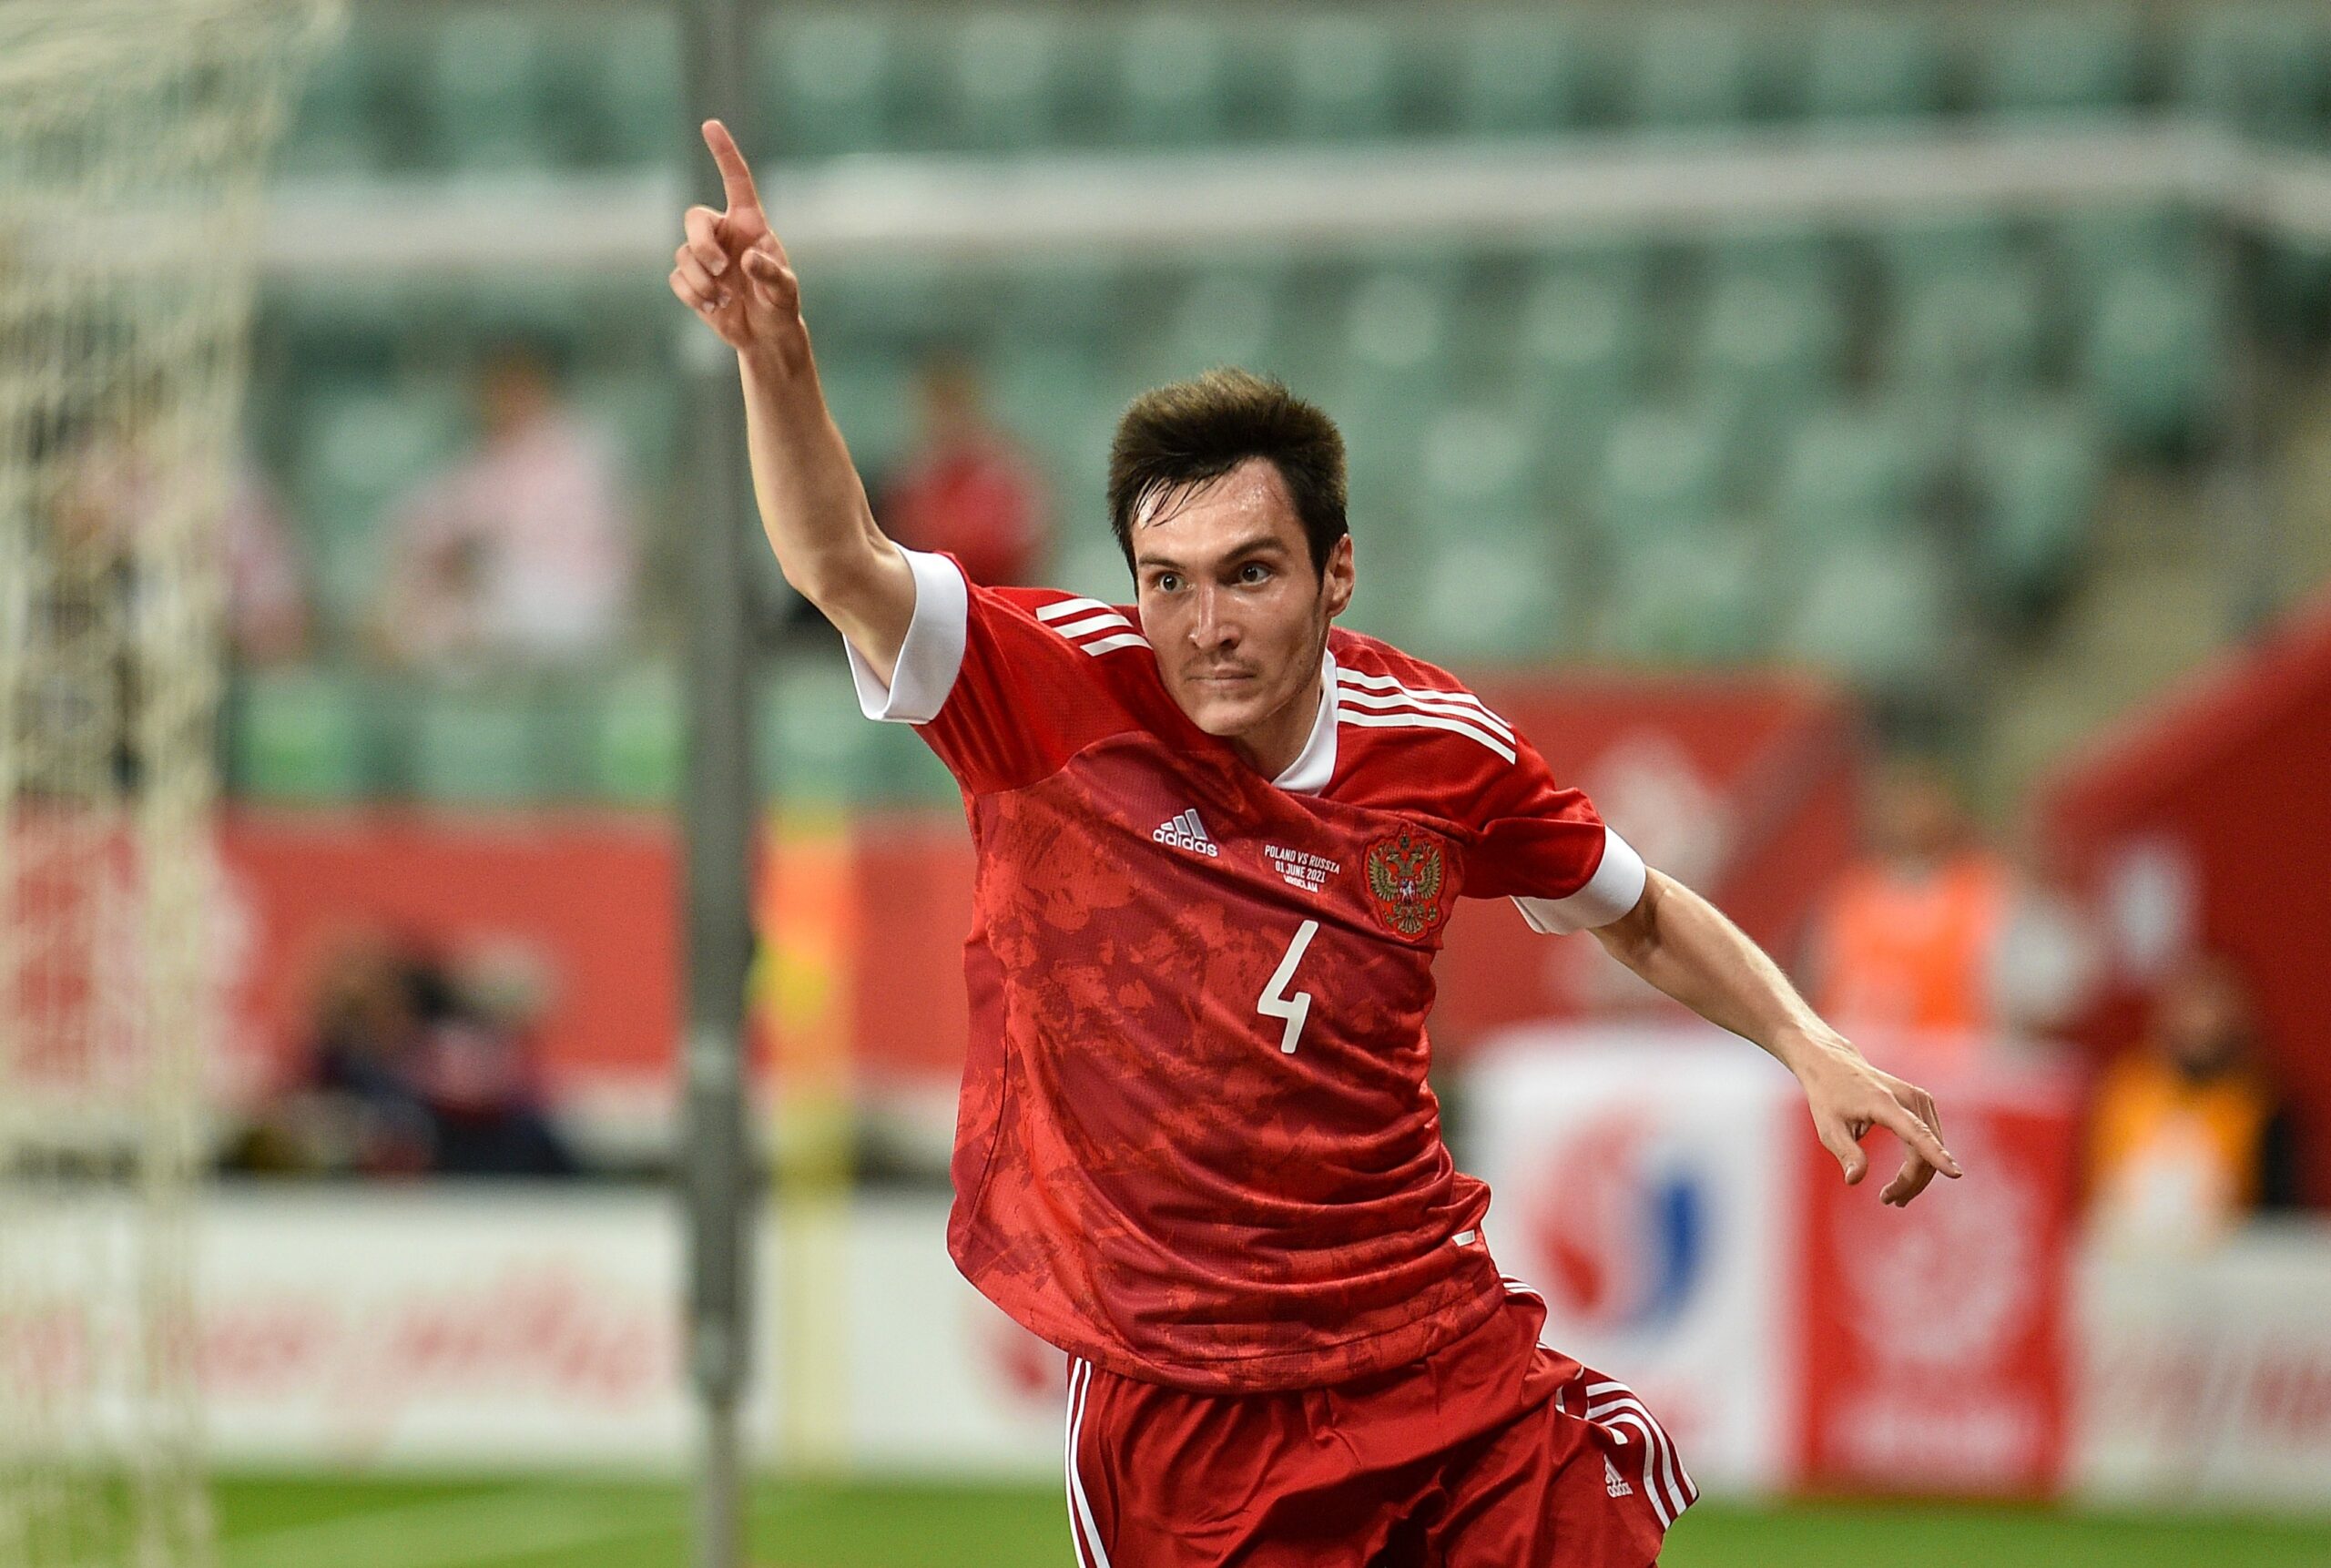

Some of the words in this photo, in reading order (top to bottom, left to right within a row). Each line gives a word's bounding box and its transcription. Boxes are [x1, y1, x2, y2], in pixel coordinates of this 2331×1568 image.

[1152, 829, 1218, 858] adidas
[1264, 844, 1297, 862] POLAND
[1298, 851, 1308, 865] VS
[1308, 855, 1340, 874] RUSSIA
[1275, 860, 1285, 873] 01
[1286, 863, 1306, 879] JUNE
[1306, 868, 1326, 883] 2021
[1257, 919, 1318, 1054] 4
